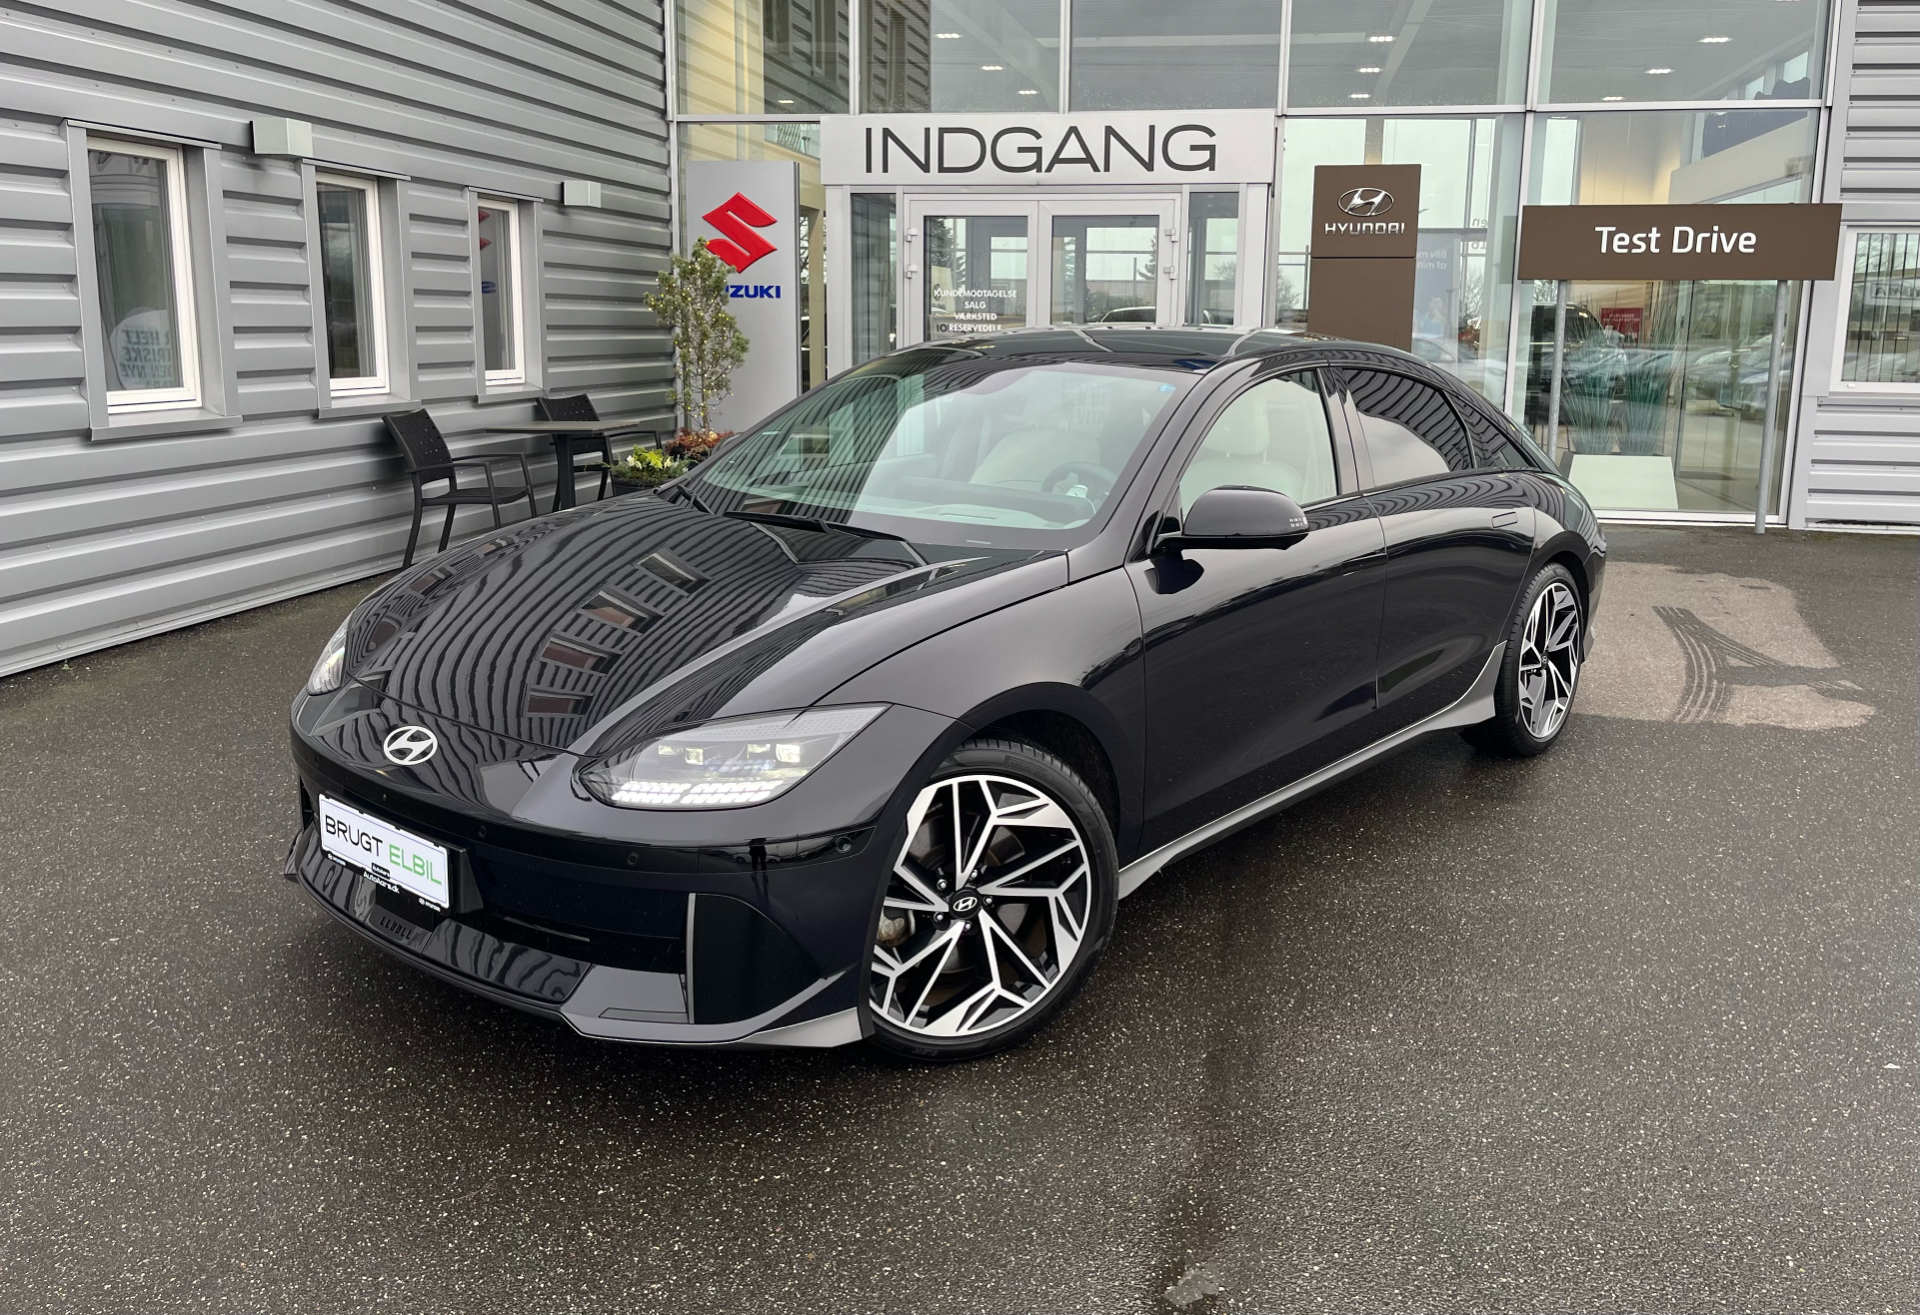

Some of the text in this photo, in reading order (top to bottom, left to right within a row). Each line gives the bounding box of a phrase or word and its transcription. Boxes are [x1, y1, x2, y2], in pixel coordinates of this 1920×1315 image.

[865, 124, 1217, 174] INDGANG
[1325, 222, 1405, 235] HYUNDAI
[1594, 226, 1757, 254] Test Drive
[933, 289, 1017, 298] KUNDEMODTAGELSE
[964, 301, 987, 309] SALG
[953, 312, 998, 321] VÆRKSTED
[325, 814, 443, 886] BRUGT ELBIL
